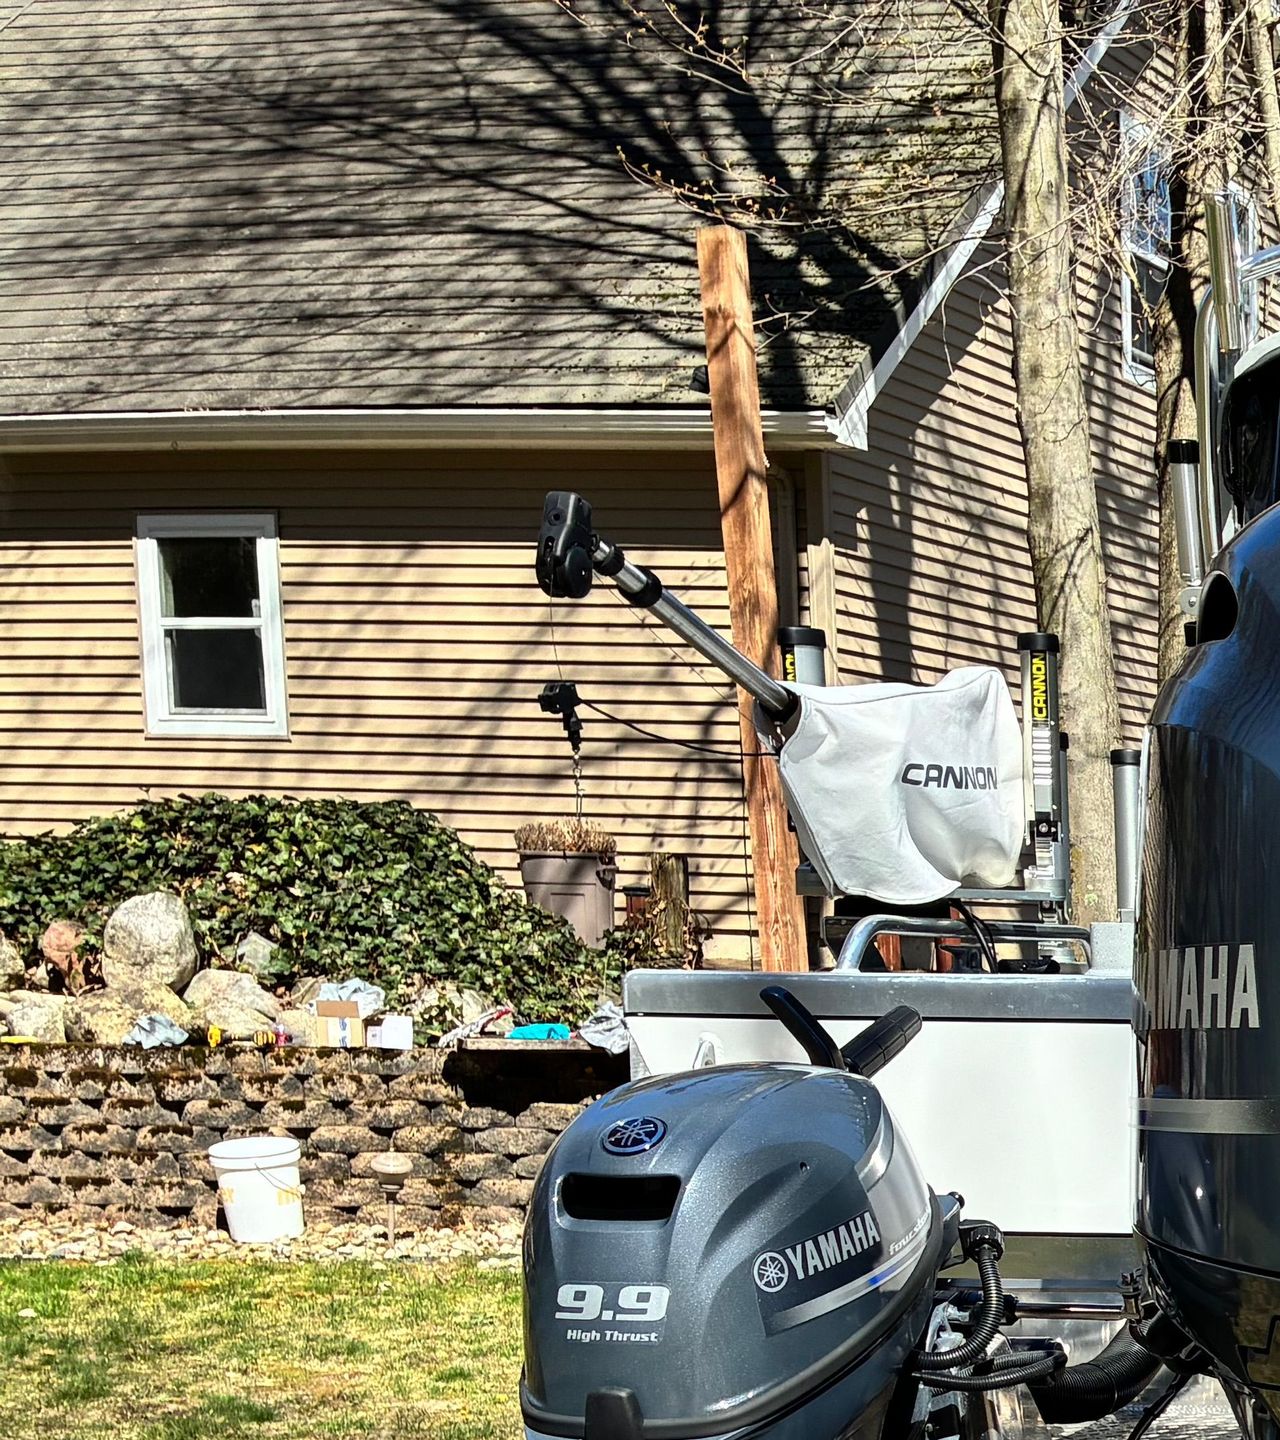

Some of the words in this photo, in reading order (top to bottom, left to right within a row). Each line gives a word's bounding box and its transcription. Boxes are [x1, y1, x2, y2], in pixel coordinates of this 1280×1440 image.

[1032, 652, 1047, 720] CANNON
[901, 763, 998, 790] CANNON
[785, 1211, 880, 1280] YAMAHA
[555, 1284, 670, 1321] 9.9
[566, 1329, 601, 1343] High
[604, 1330, 659, 1342] Thrust
